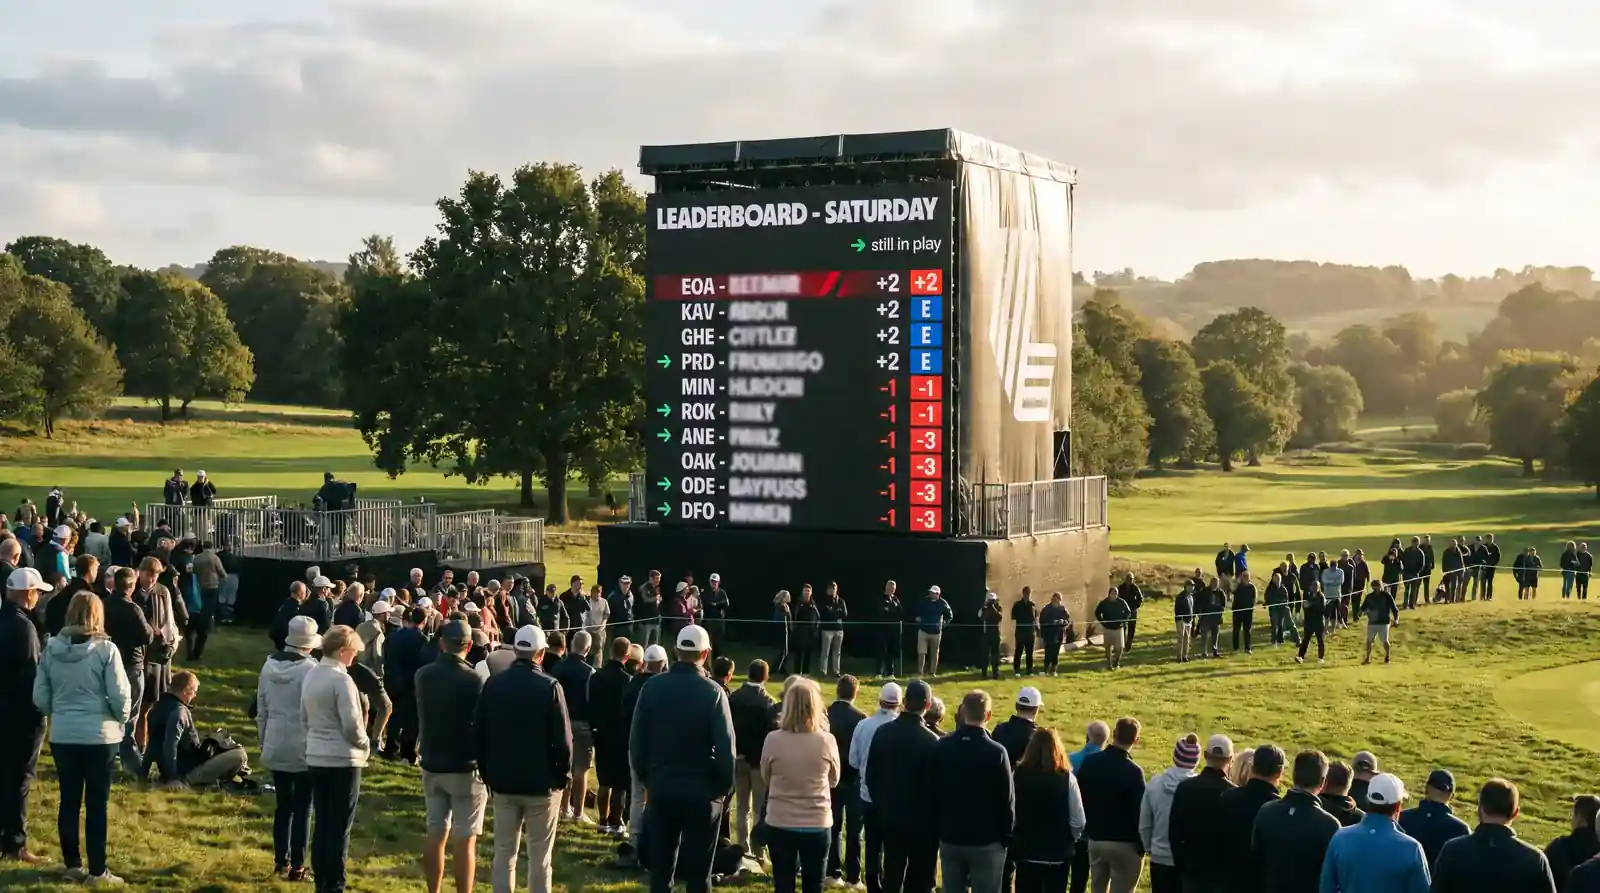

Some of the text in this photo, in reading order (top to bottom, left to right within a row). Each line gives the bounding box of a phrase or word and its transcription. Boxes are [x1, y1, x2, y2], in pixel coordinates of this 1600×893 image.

[657, 203, 807, 229] LEADERBOARD
[825, 197, 938, 224] SATURDAY
[871, 235, 942, 254] still in play
[681, 277, 716, 296] EOA
[877, 274, 899, 292] +2
[914, 273, 938, 290] +2
[681, 302, 715, 321] KAV
[877, 300, 899, 318] +2
[922, 300, 931, 317] E
[681, 327, 715, 346] GHE
[877, 326, 899, 344] +2
[922, 327, 931, 343] E
[681, 352, 715, 371] PRD
[877, 353, 899, 370] +2
[922, 353, 931, 370] E
[681, 377, 715, 396] MIN
[880, 378, 896, 396] -1
[919, 380, 933, 396] -1
[681, 402, 716, 421] ROK
[880, 405, 896, 423] -1
[919, 406, 934, 422] -1
[681, 427, 715, 445] ANE
[880, 431, 896, 448] -1
[917, 432, 936, 449] -3
[681, 451, 716, 470] OAK
[880, 457, 896, 474] -1
[917, 458, 936, 475] -3
[681, 476, 716, 495] ODE
[880, 483, 896, 500] -1
[917, 484, 936, 501] -3
[681, 501, 715, 520] DFO
[880, 509, 896, 526] -1
[917, 511, 936, 528] -3
